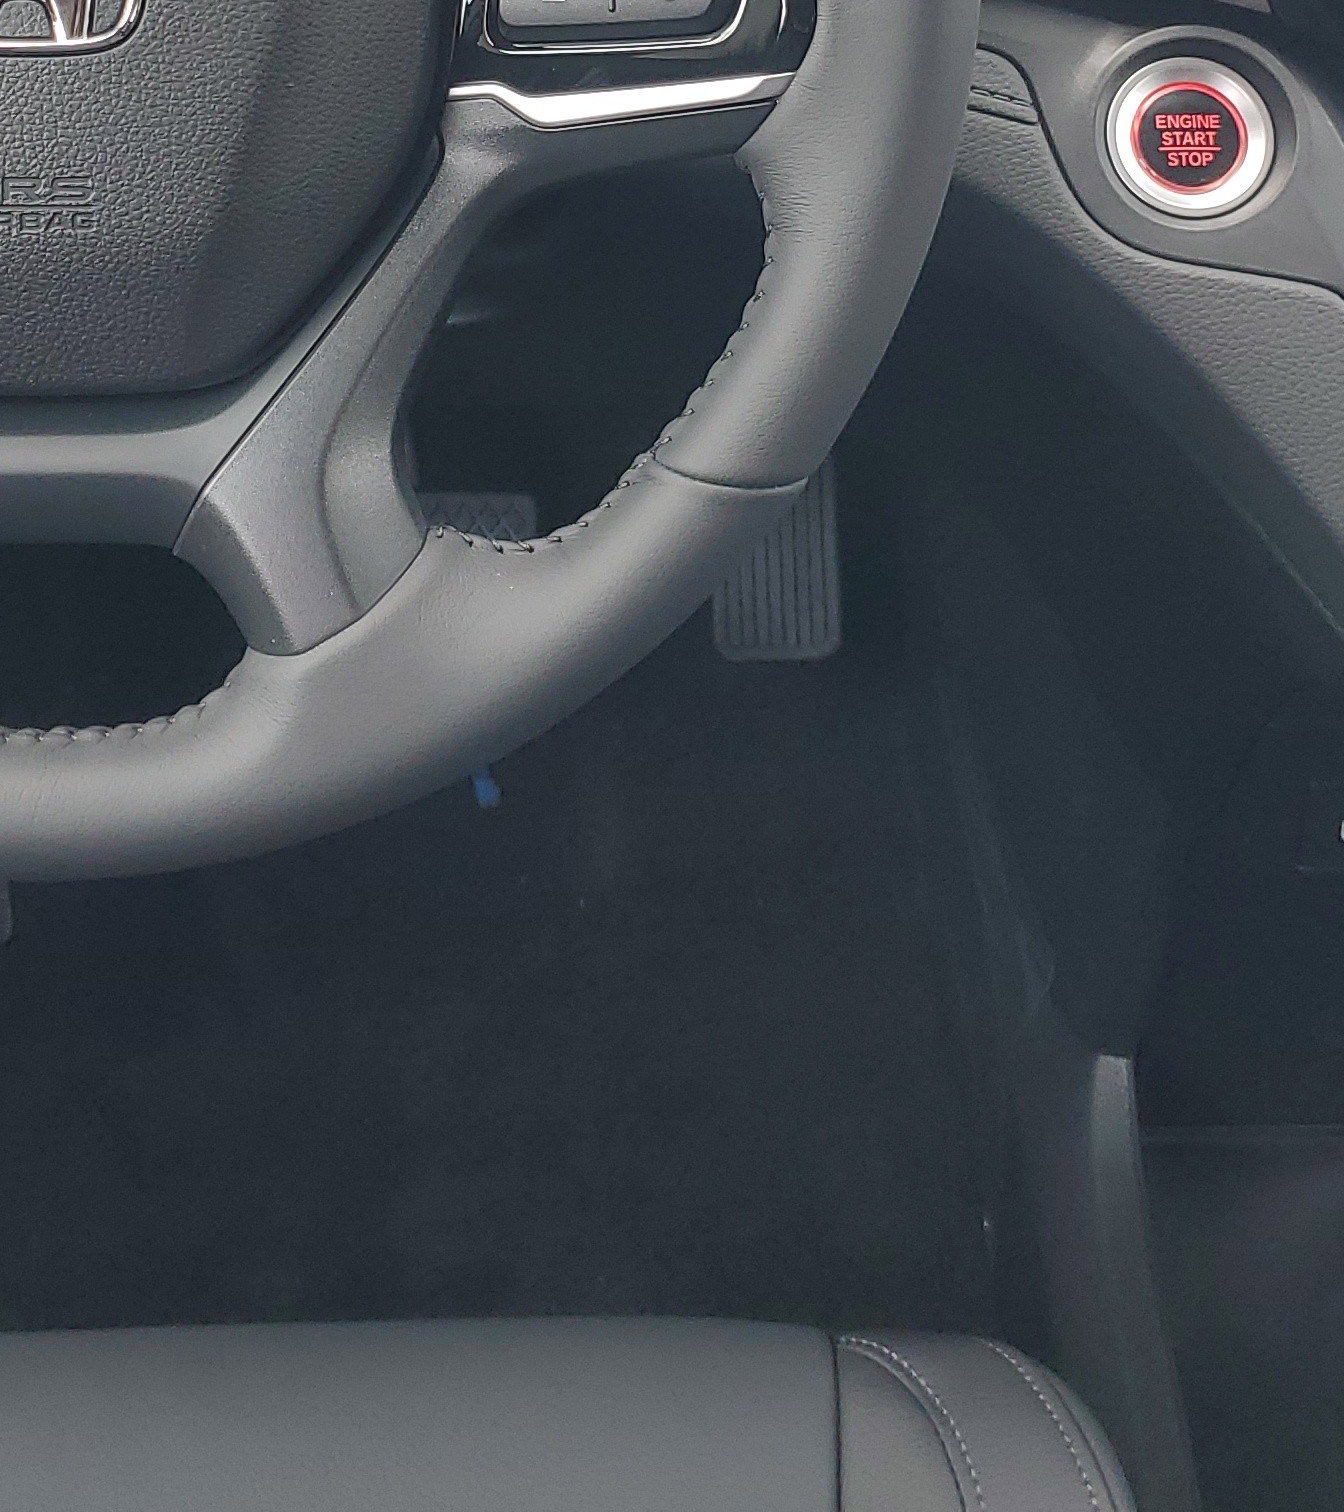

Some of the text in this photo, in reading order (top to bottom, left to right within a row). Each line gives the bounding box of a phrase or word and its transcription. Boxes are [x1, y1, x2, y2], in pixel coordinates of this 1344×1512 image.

[1154, 113, 1221, 131] ENGINE
[1161, 130, 1217, 147] START
[1166, 150, 1214, 167] STOP
